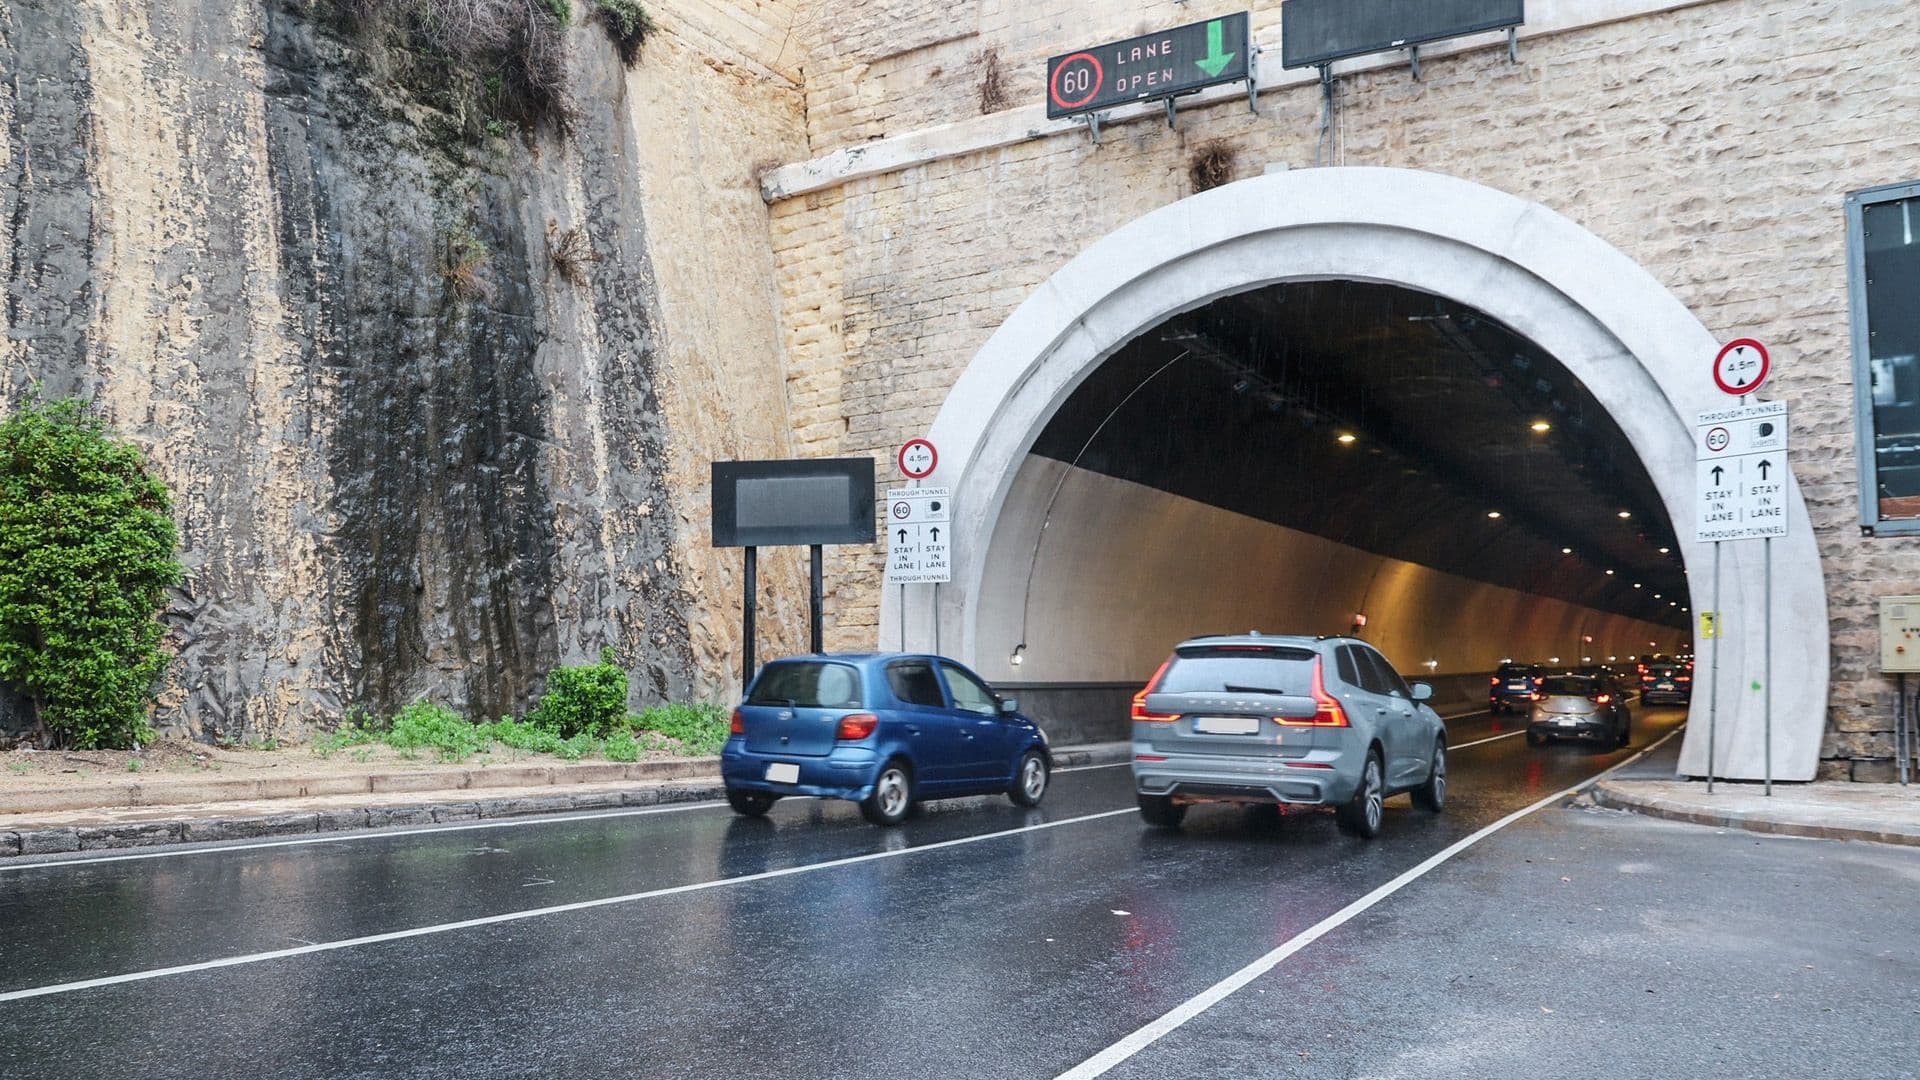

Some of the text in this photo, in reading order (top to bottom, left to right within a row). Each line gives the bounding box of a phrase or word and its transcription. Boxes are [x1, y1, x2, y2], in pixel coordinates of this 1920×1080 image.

[1117, 40, 1172, 65] LANE
[1064, 68, 1089, 94] 60
[1117, 68, 1173, 92] OPEN
[1727, 360, 1757, 372] 4.5m
[1699, 404, 1784, 421] THROUGH TUNNEL
[1709, 434, 1726, 445] 60
[889, 489, 920, 497] THROUGH
[1705, 490, 1733, 501] STAY
[1751, 484, 1780, 496] STAY
[1712, 502, 1724, 511] IN
[1758, 497, 1771, 506] IN
[896, 505, 908, 514] 60
[1750, 507, 1781, 518] LANE
[1704, 512, 1734, 523] LANE
[1699, 525, 1784, 539] THROUGH TUNNEL
[930, 553, 940, 561] IN
